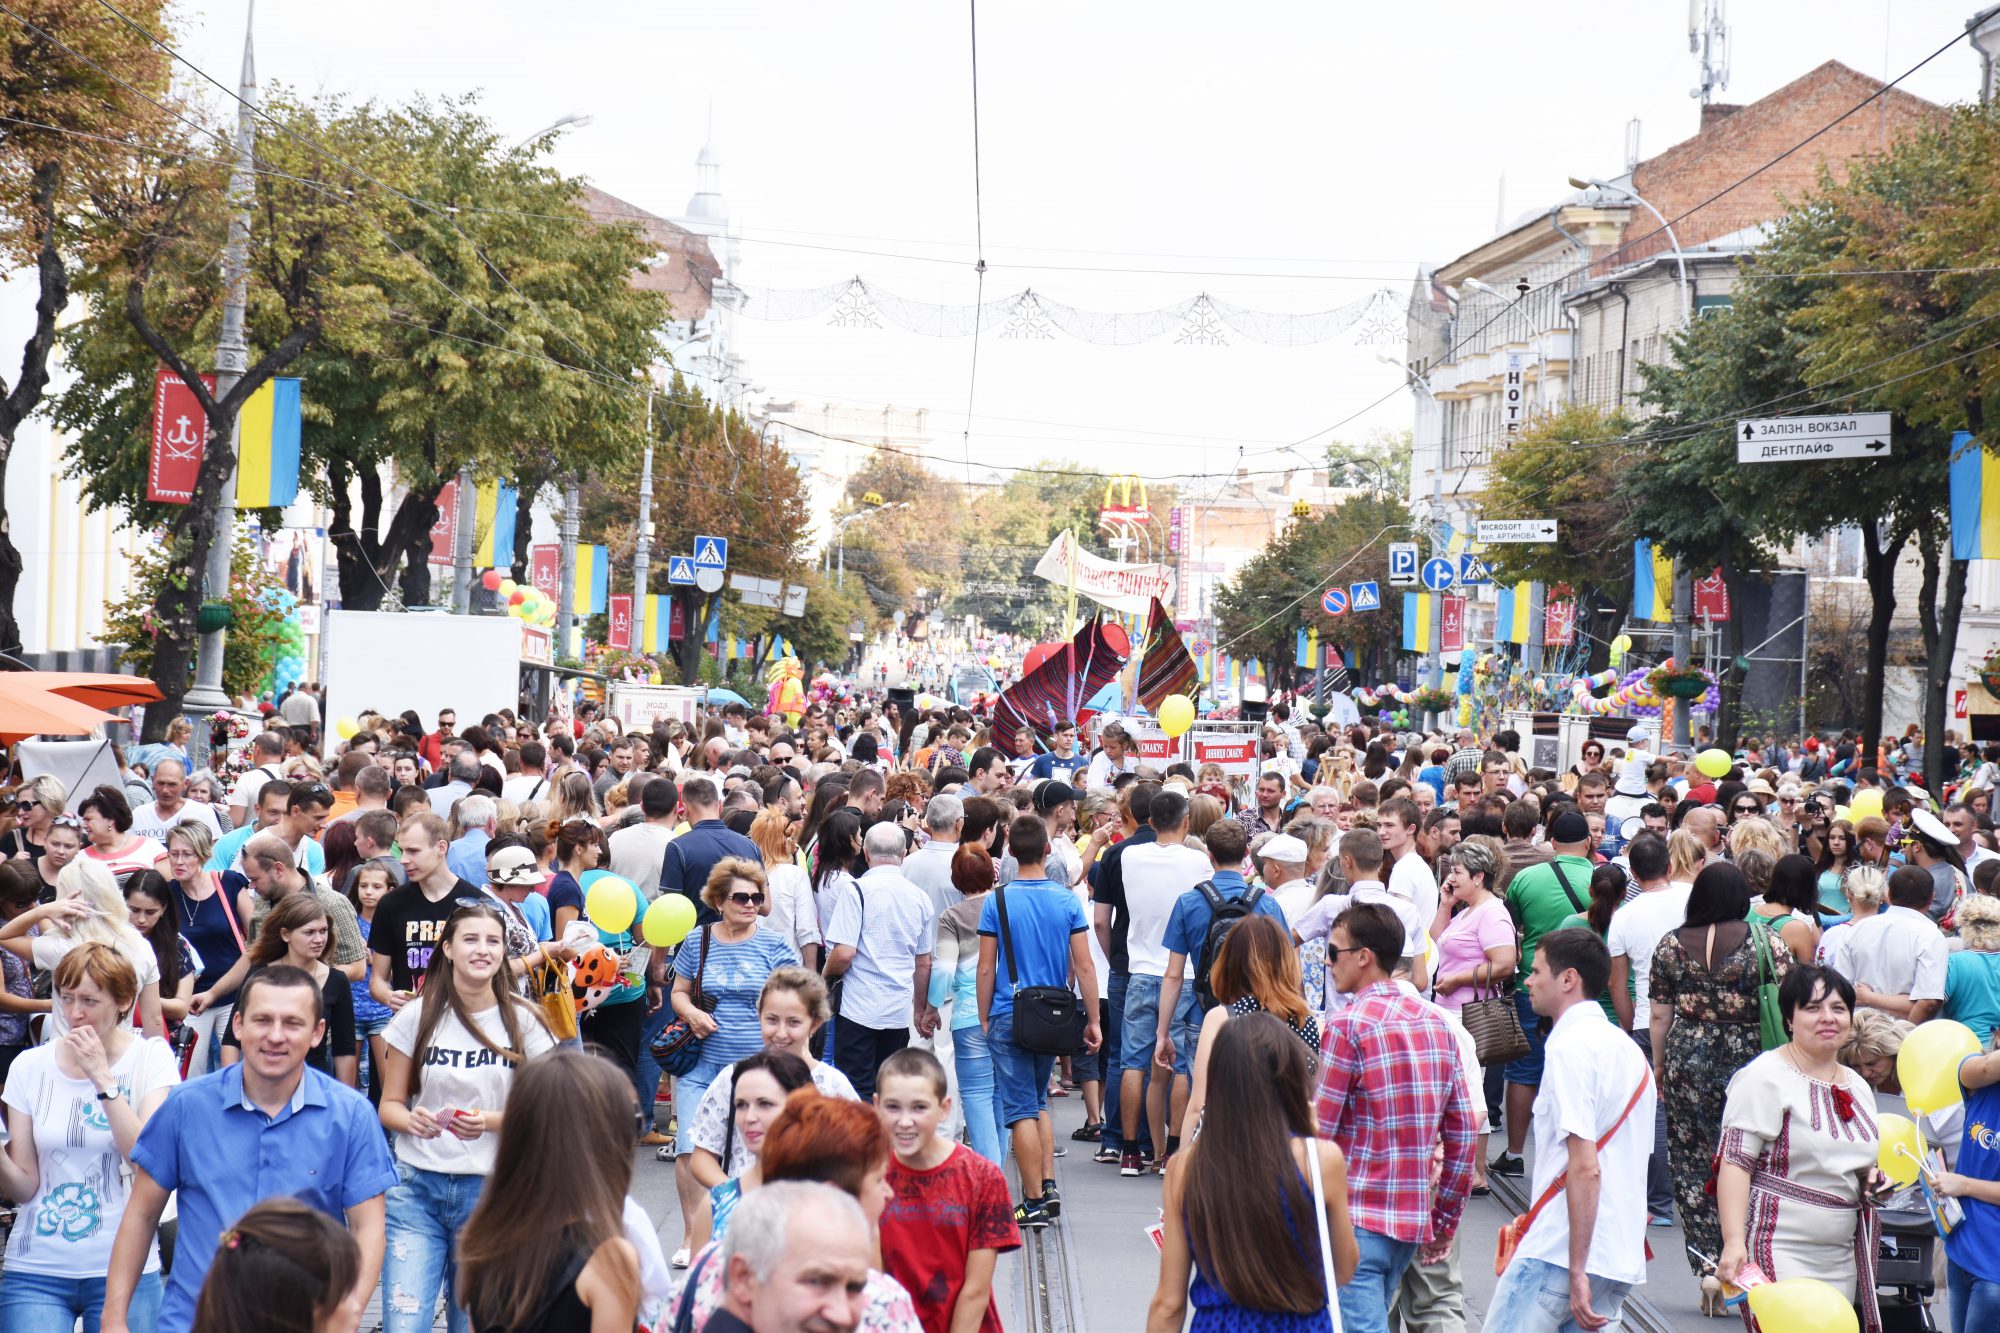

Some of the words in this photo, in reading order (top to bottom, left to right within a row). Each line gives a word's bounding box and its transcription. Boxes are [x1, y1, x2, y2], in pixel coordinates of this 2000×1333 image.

[1760, 423, 1806, 435] ЗАЛІЗН.
[1808, 421, 1857, 432] ВОКЗАЛ
[1761, 441, 1834, 457] ДЕНТЛАЙФ
[1480, 523, 1521, 531] MICROSOFT
[1497, 532, 1536, 540] АРТИНОВА
